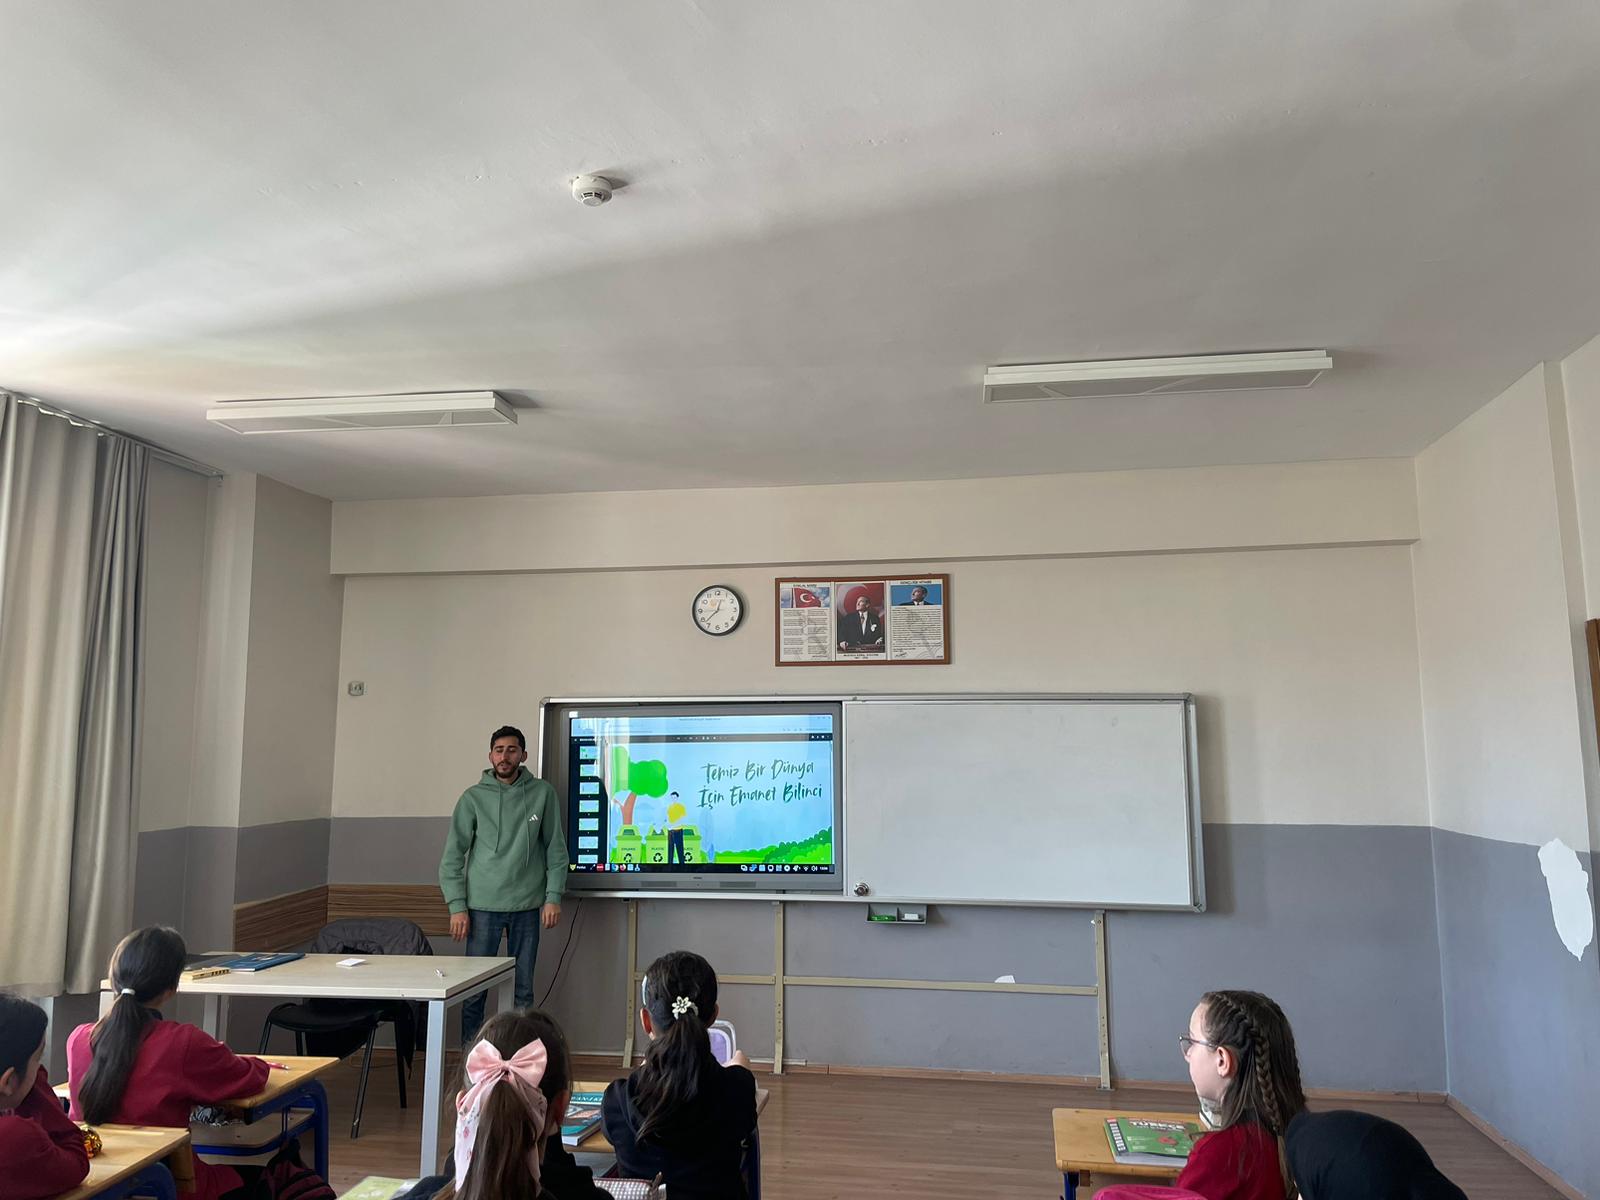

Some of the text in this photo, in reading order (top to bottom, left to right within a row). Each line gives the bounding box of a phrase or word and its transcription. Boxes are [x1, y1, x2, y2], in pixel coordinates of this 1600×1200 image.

[701, 759, 814, 784] Temiz Bir Dünya
[696, 782, 822, 810] İçin Emanet Bilinci
